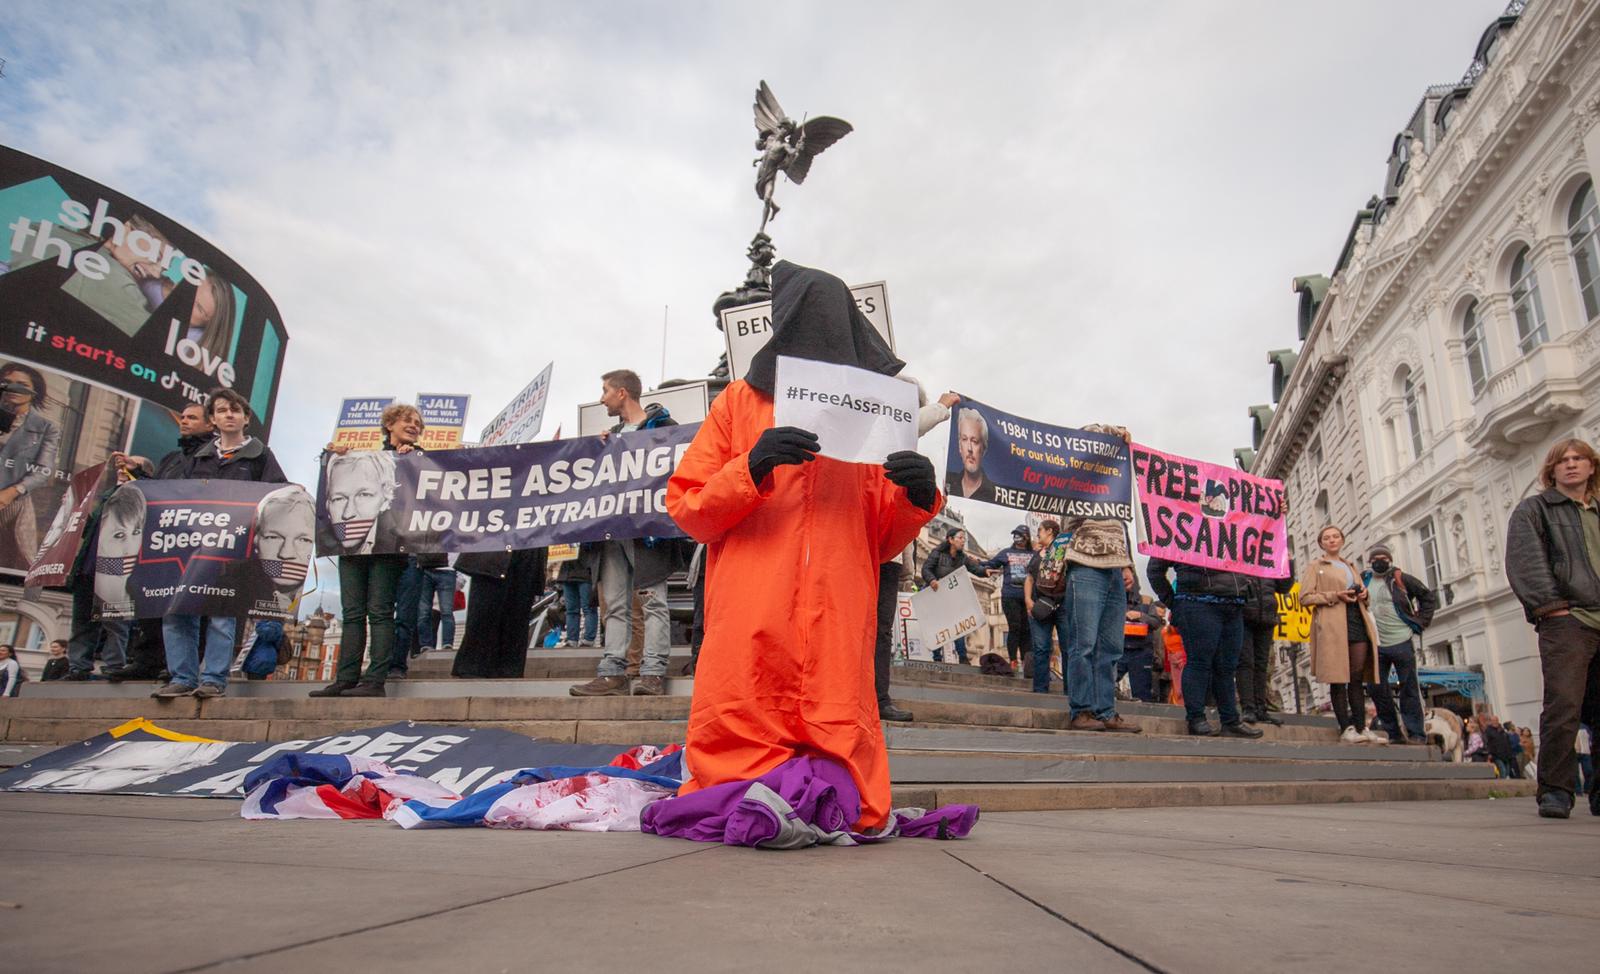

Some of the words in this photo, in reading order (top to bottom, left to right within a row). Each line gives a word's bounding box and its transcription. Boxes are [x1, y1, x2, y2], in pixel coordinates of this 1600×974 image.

[9, 216, 110, 280] the
[57, 198, 207, 286] share
[737, 316, 773, 337] BEN
[26, 321, 47, 343] it
[51, 333, 126, 370] starts
[130, 363, 156, 382] on
[181, 382, 211, 406] TikT
[164, 318, 236, 388] love
[350, 401, 382, 412] JAIL
[425, 398, 458, 410] JAIL
[511, 374, 546, 414] TRIAL
[786, 385, 913, 424] #FreeAssange
[423, 409, 439, 417] THE
[440, 410, 459, 418] WAR
[337, 431, 381, 442] FREE
[423, 430, 458, 442] REE
[1032, 430, 1043, 445] IS
[1045, 433, 1062, 449] SO
[1010, 442, 1025, 457] For
[1028, 449, 1044, 461] our
[1045, 452, 1069, 468] kids,
[1070, 456, 1084, 470] for
[25, 462, 72, 482] WORL
[415, 466, 513, 501] FREE
[1023, 465, 1043, 483] for
[1043, 472, 1070, 490] your
[1132, 449, 1200, 503] FREE
[1228, 477, 1283, 520] PRESS
[408, 509, 452, 533] NO
[458, 509, 511, 534] U.S.
[516, 488, 668, 530] EXTRADITIO
[994, 485, 1027, 508] FREE
[1027, 492, 1067, 513] JULIAN
[1066, 499, 1132, 521] ASSANGE
[159, 508, 231, 528] #Free
[188, 583, 237, 598] crimes
